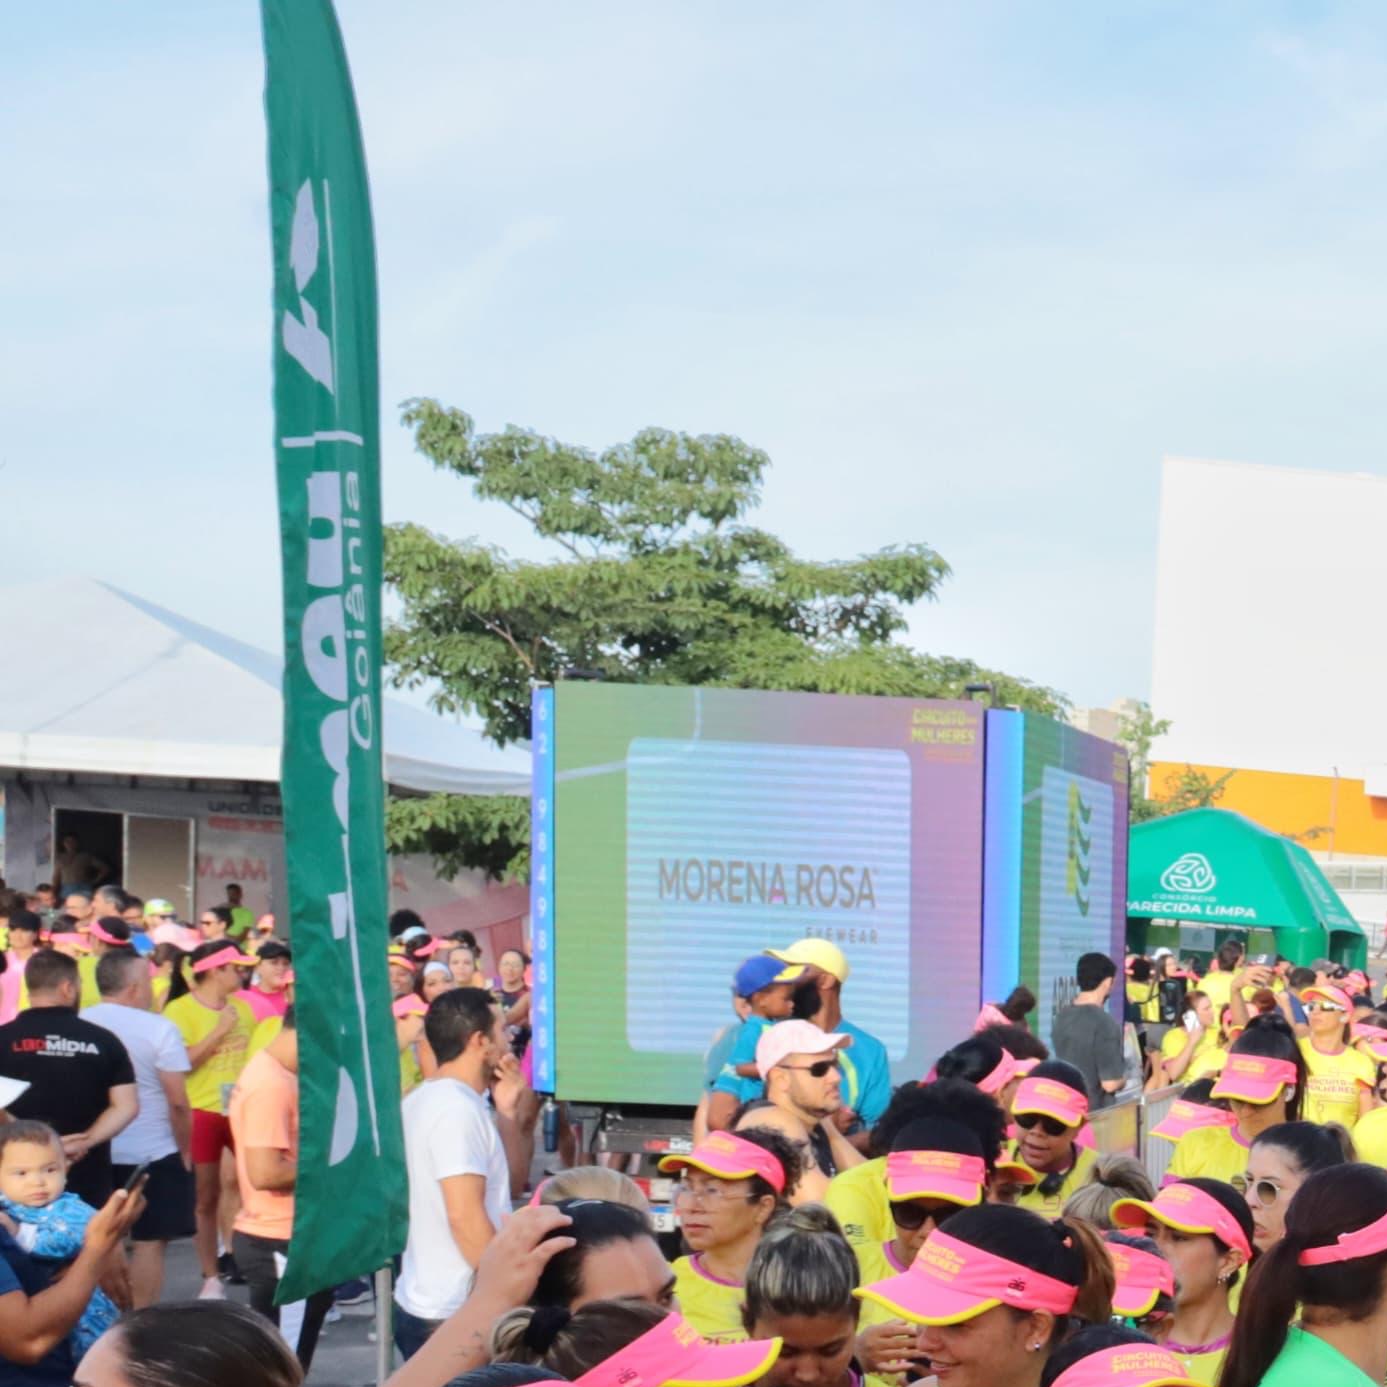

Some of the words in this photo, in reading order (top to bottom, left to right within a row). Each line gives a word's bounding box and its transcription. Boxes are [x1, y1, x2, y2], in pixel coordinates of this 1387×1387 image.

[658, 857, 788, 904] MORENA
[796, 863, 876, 908] ROSA
[1127, 901, 1201, 916] ARECIDA
[1205, 905, 1256, 918] LIMPA
